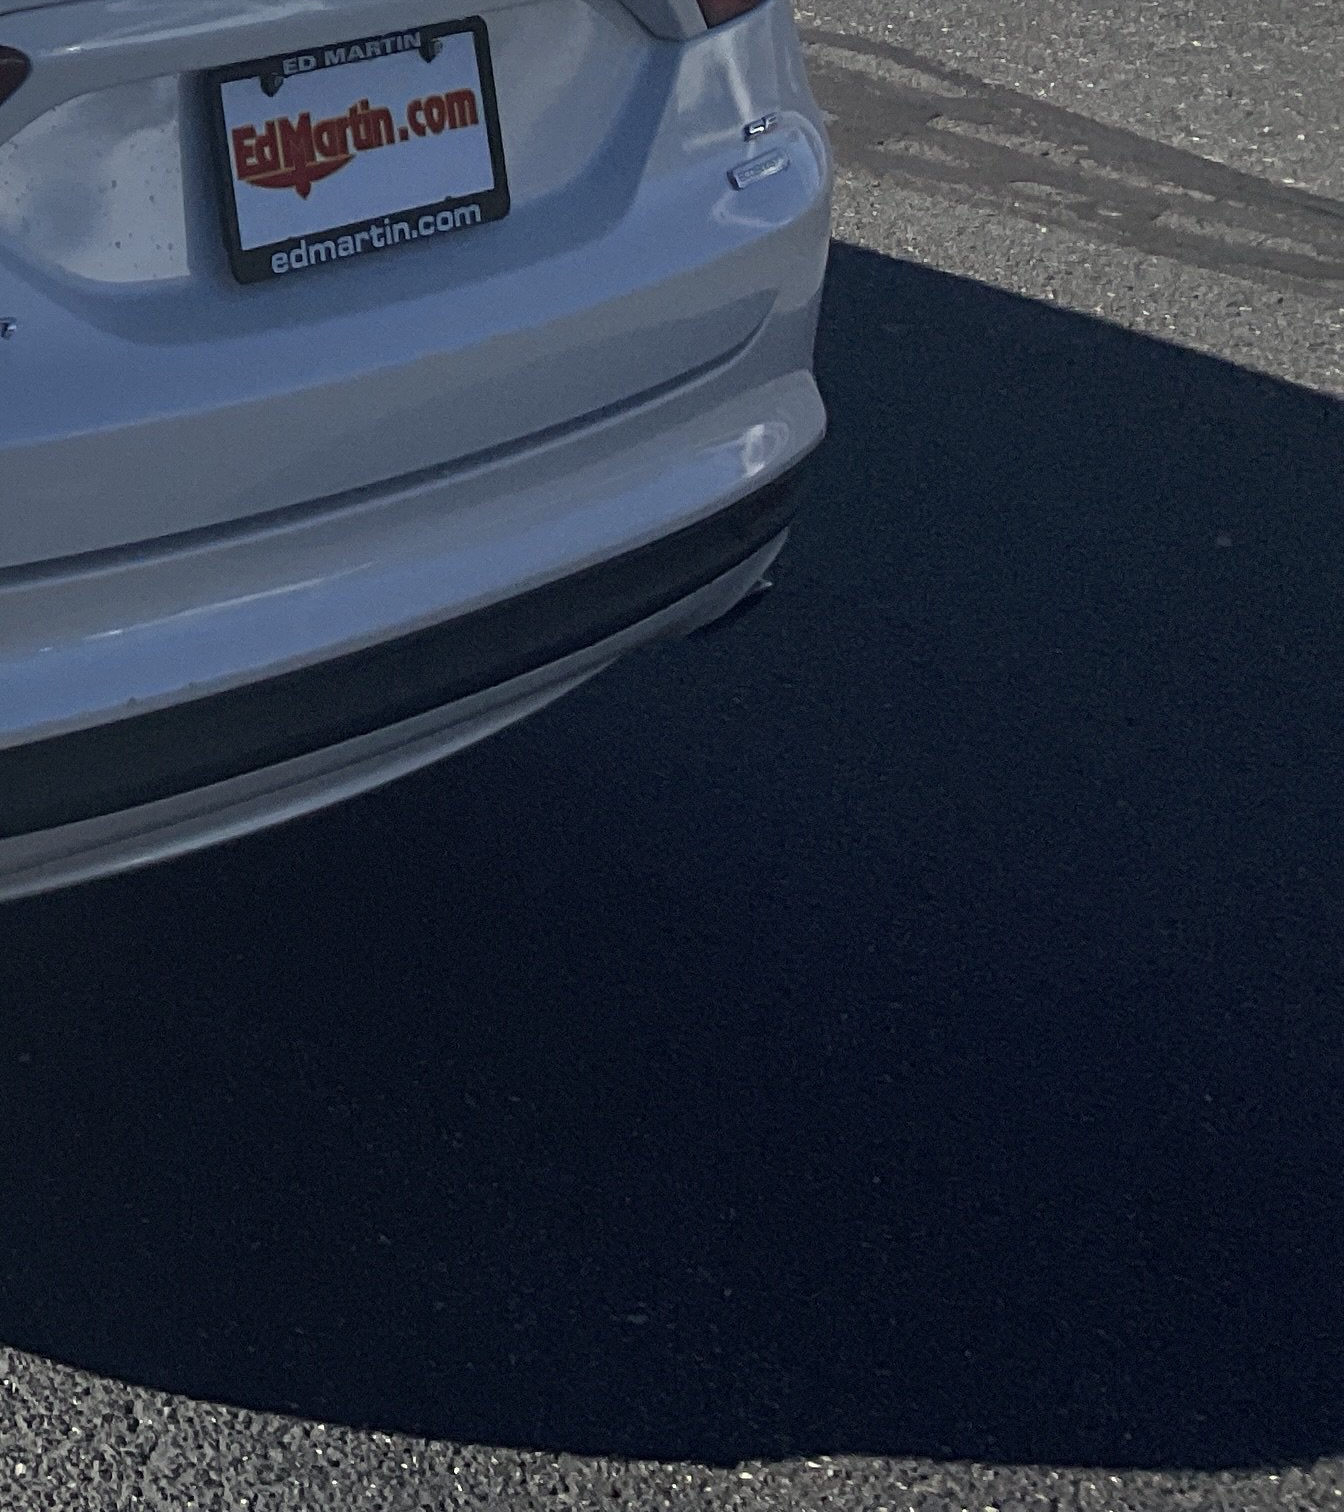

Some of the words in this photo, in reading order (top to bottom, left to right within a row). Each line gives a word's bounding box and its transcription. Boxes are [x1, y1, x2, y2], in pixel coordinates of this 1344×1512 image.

[282, 58, 317, 75] ED
[324, 31, 423, 65] MARTIN
[231, 88, 479, 181] EdMartin.com
[271, 202, 482, 275] edmartin.com
